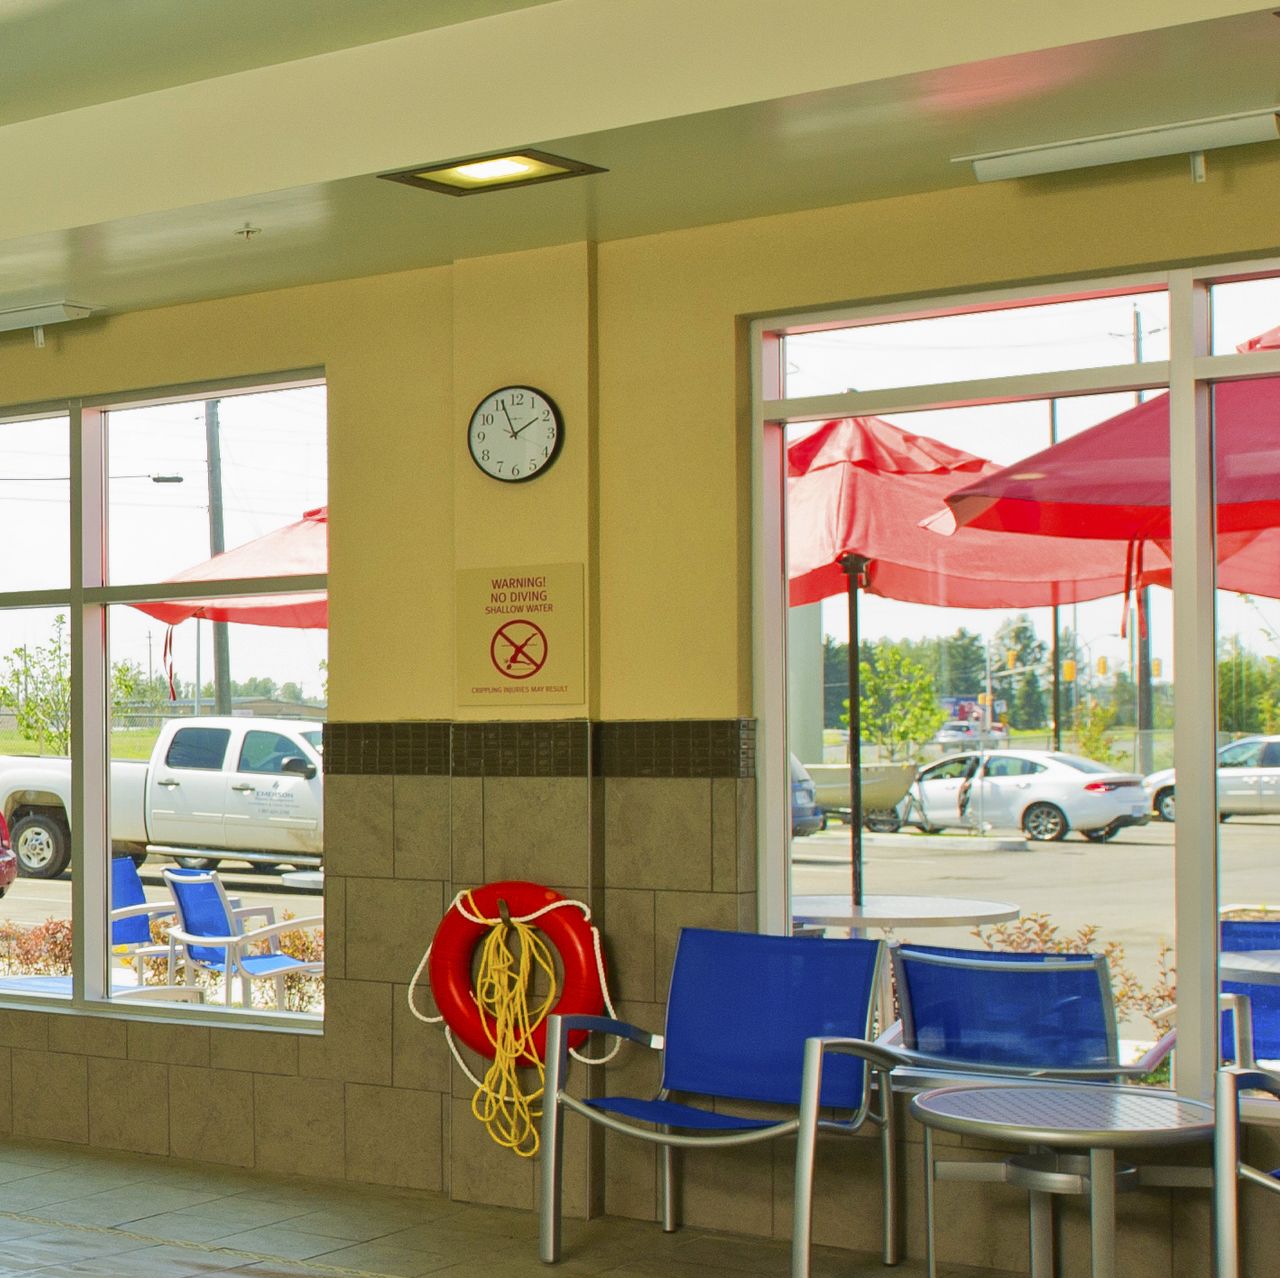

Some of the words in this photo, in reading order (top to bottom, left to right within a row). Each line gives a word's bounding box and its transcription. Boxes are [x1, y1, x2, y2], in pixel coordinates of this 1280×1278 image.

[511, 393, 524, 406] 12
[530, 397, 535, 409] 1
[480, 413, 494, 426] 10
[542, 409, 550, 422] 2
[477, 431, 486, 443] 9
[547, 428, 555, 439] 3
[482, 448, 490, 461] 8
[541, 446, 548, 458] 4
[497, 461, 504, 473] 7
[511, 464, 520, 476] 6
[528, 459, 537, 471] 5
[492, 577, 546, 589] WARNING!
[491, 592, 506, 603] NO
[510, 591, 547, 602] DIVING
[485, 604, 524, 615] SHALLOW
[526, 603, 553, 613] WATER
